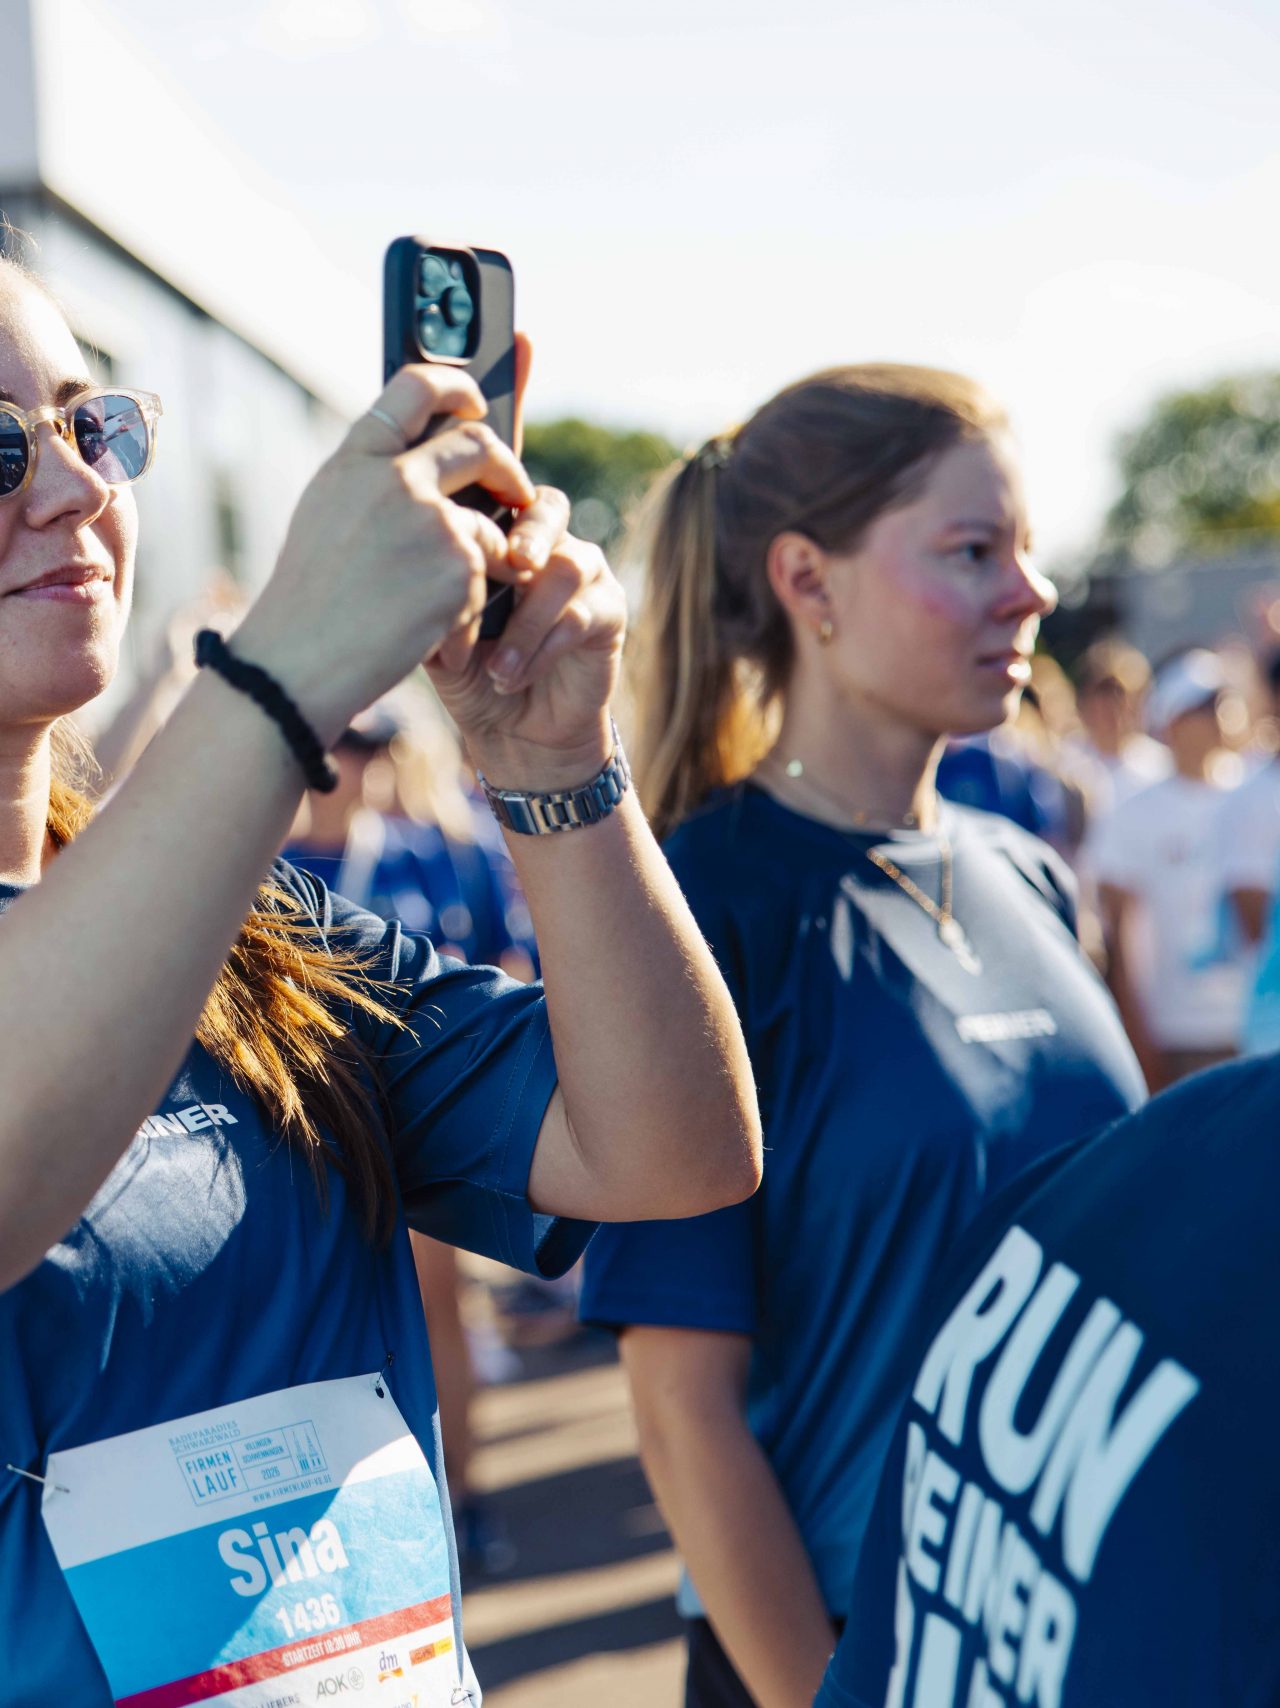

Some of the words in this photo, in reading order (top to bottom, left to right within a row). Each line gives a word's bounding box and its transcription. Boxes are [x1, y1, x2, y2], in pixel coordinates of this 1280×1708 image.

[136, 1103, 239, 1138] INER
[913, 1224, 1200, 1585] RUN
[168, 1420, 238, 1447] BADEPARADIES
[172, 1429, 241, 1455] SCHWARZWALD
[185, 1450, 232, 1475] FIRMEN
[192, 1467, 238, 1498] LAUF
[218, 1519, 350, 1597] Sina
[275, 1593, 341, 1638] 1436
[282, 1641, 324, 1667] STARTZEIT
[343, 1631, 362, 1648] UHR
[379, 1650, 399, 1672] dm
[316, 1673, 349, 1699] AOK
